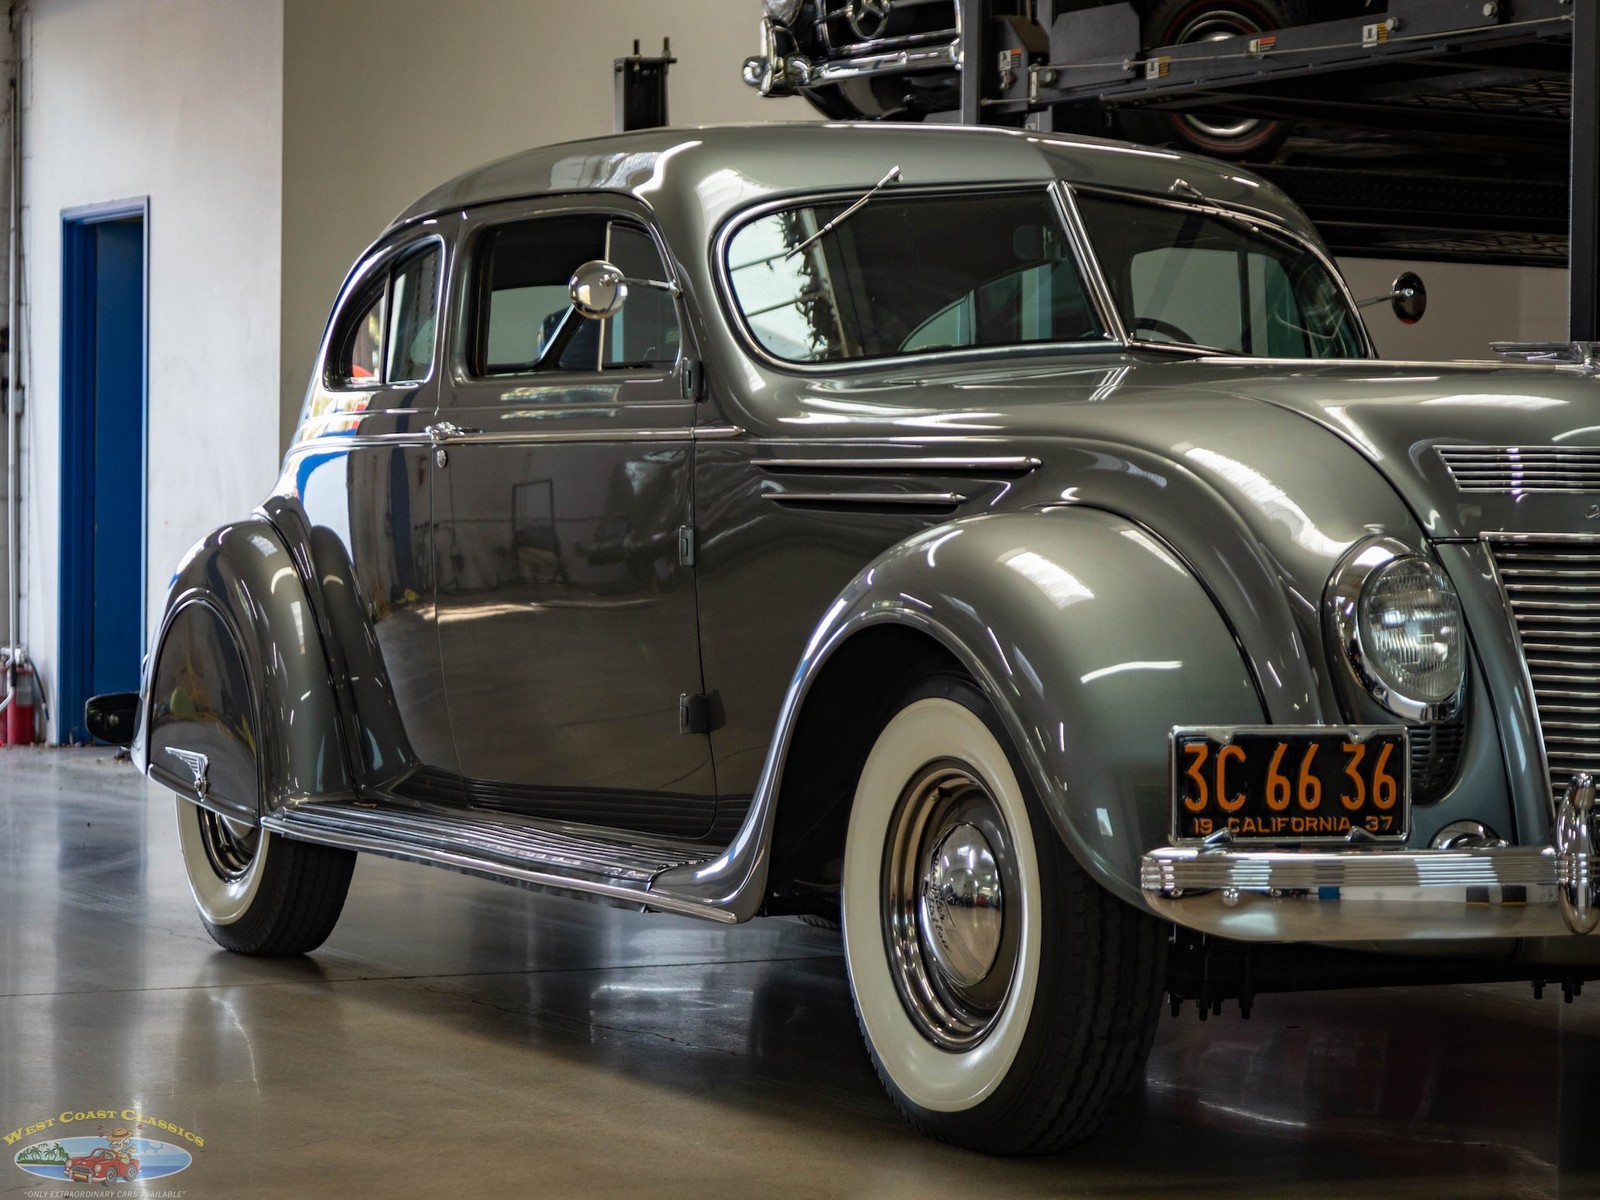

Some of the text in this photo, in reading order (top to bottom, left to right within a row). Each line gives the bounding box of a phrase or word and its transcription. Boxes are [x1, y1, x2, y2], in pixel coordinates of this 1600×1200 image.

[1184, 742, 1397, 812] 3C 66 36
[1195, 815, 1393, 834] 19 CALIFORNIA 37
